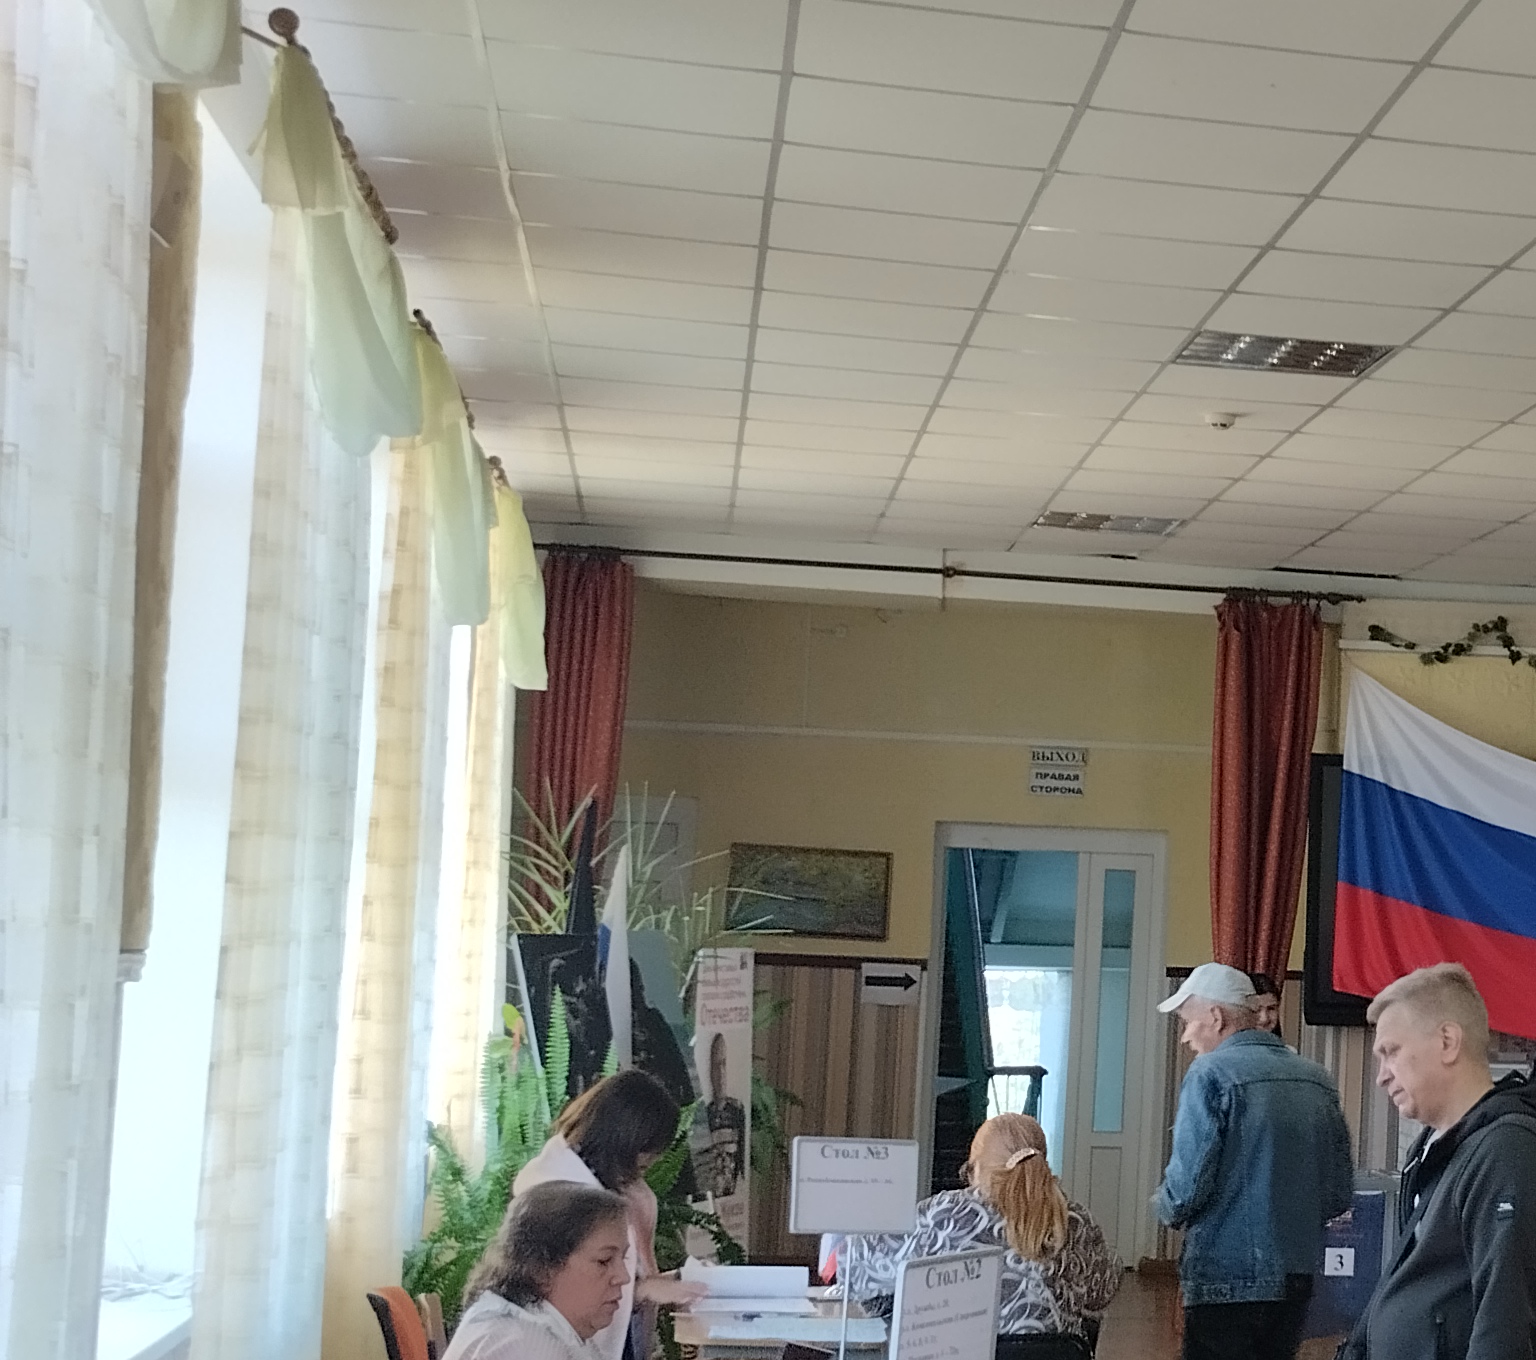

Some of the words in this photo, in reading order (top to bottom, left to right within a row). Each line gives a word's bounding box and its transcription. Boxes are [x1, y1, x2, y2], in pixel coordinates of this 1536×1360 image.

[1031, 750, 1087, 763] ВЫХОД
[1035, 771, 1080, 782] ПРАВАЯ
[1030, 784, 1084, 795] СТОРОНА
[820, 1144, 860, 1159] Стол
[863, 1145, 889, 1160] №3
[1333, 1253, 1344, 1272] 3
[925, 1265, 958, 1289] Стол
[961, 1258, 982, 1283] №2
